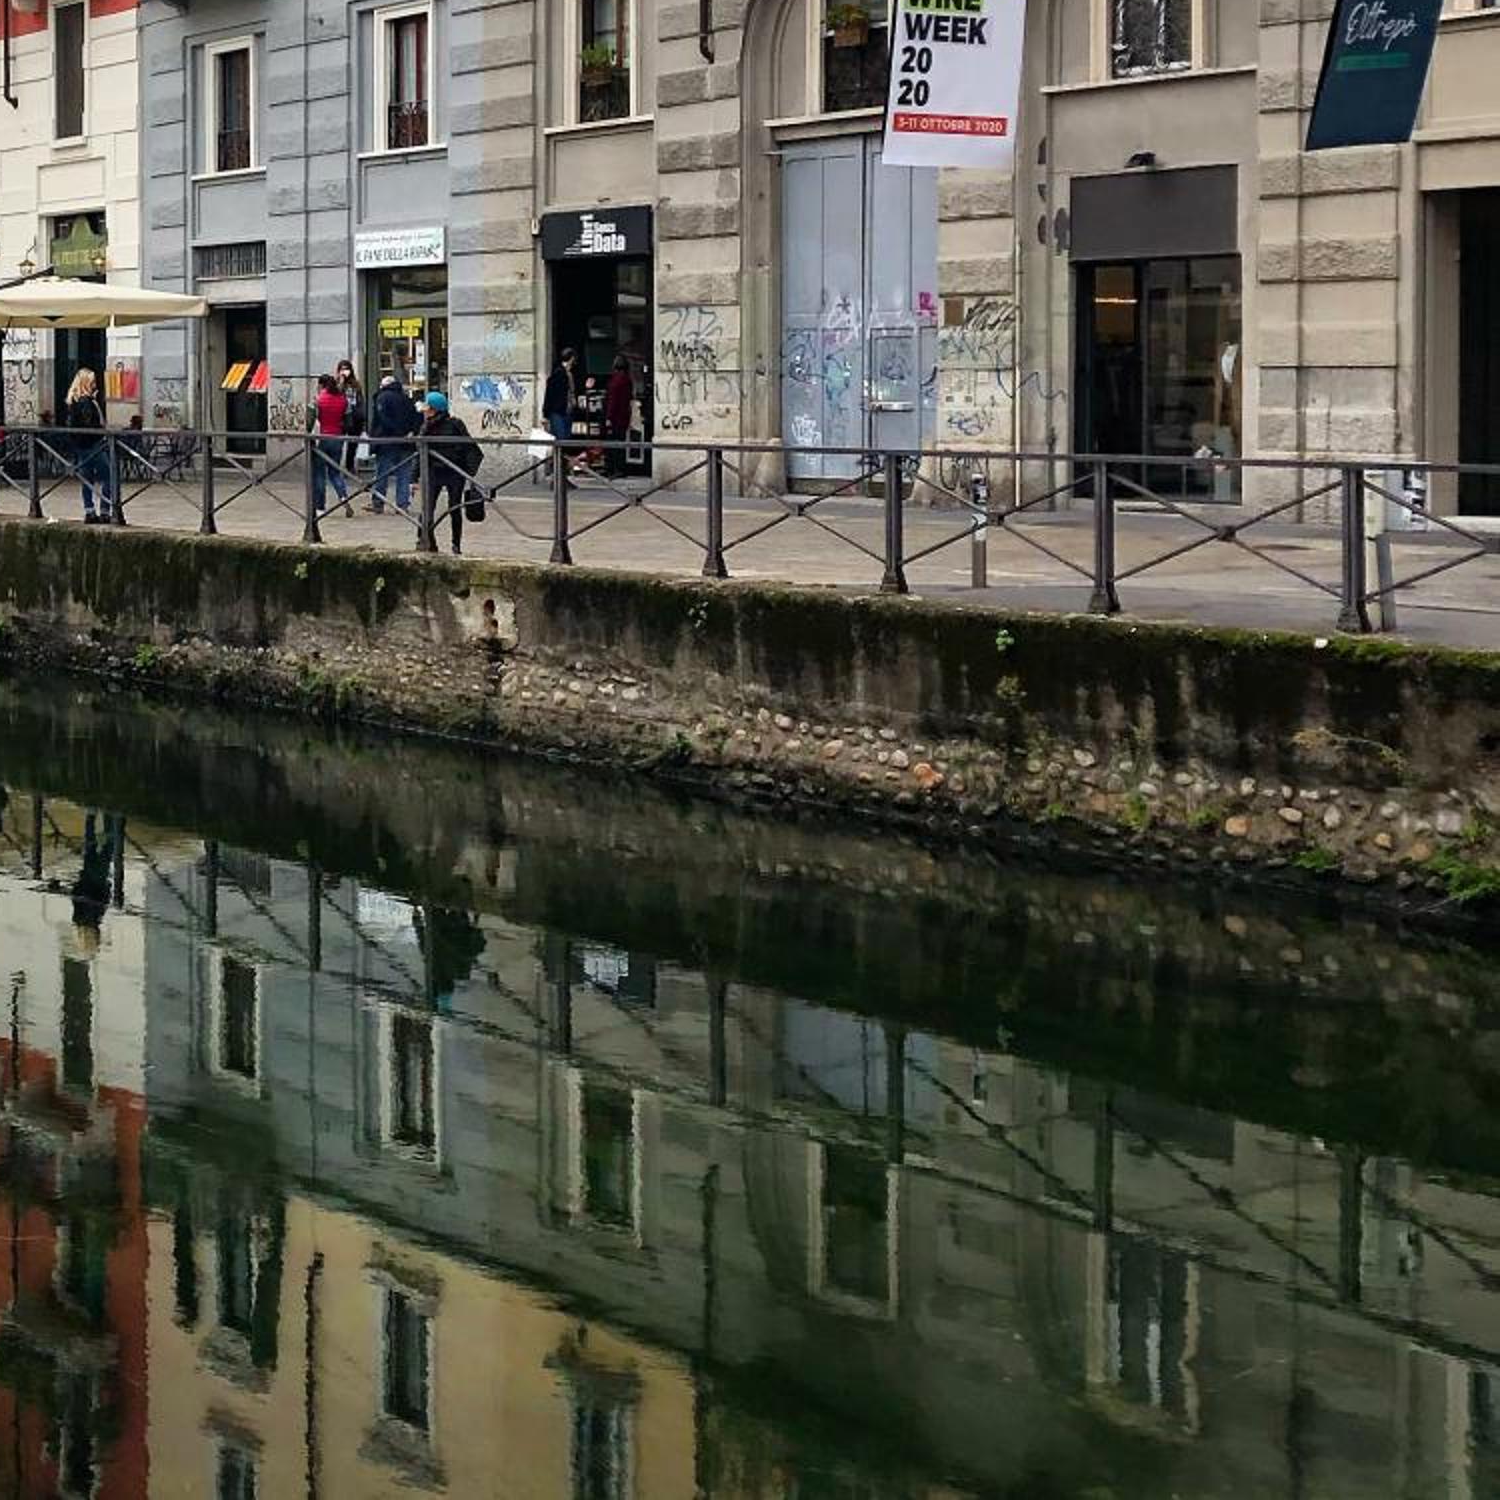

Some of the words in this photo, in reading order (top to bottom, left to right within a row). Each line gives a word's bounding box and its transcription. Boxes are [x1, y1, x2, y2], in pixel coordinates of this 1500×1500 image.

[904, 12, 988, 45] WEEK
[1345, 0, 1419, 52] Oltrepò
[901, 46, 932, 74] 20
[897, 79, 930, 107] 20
[975, 121, 1003, 133] 2020
[593, 233, 626, 253] Data
